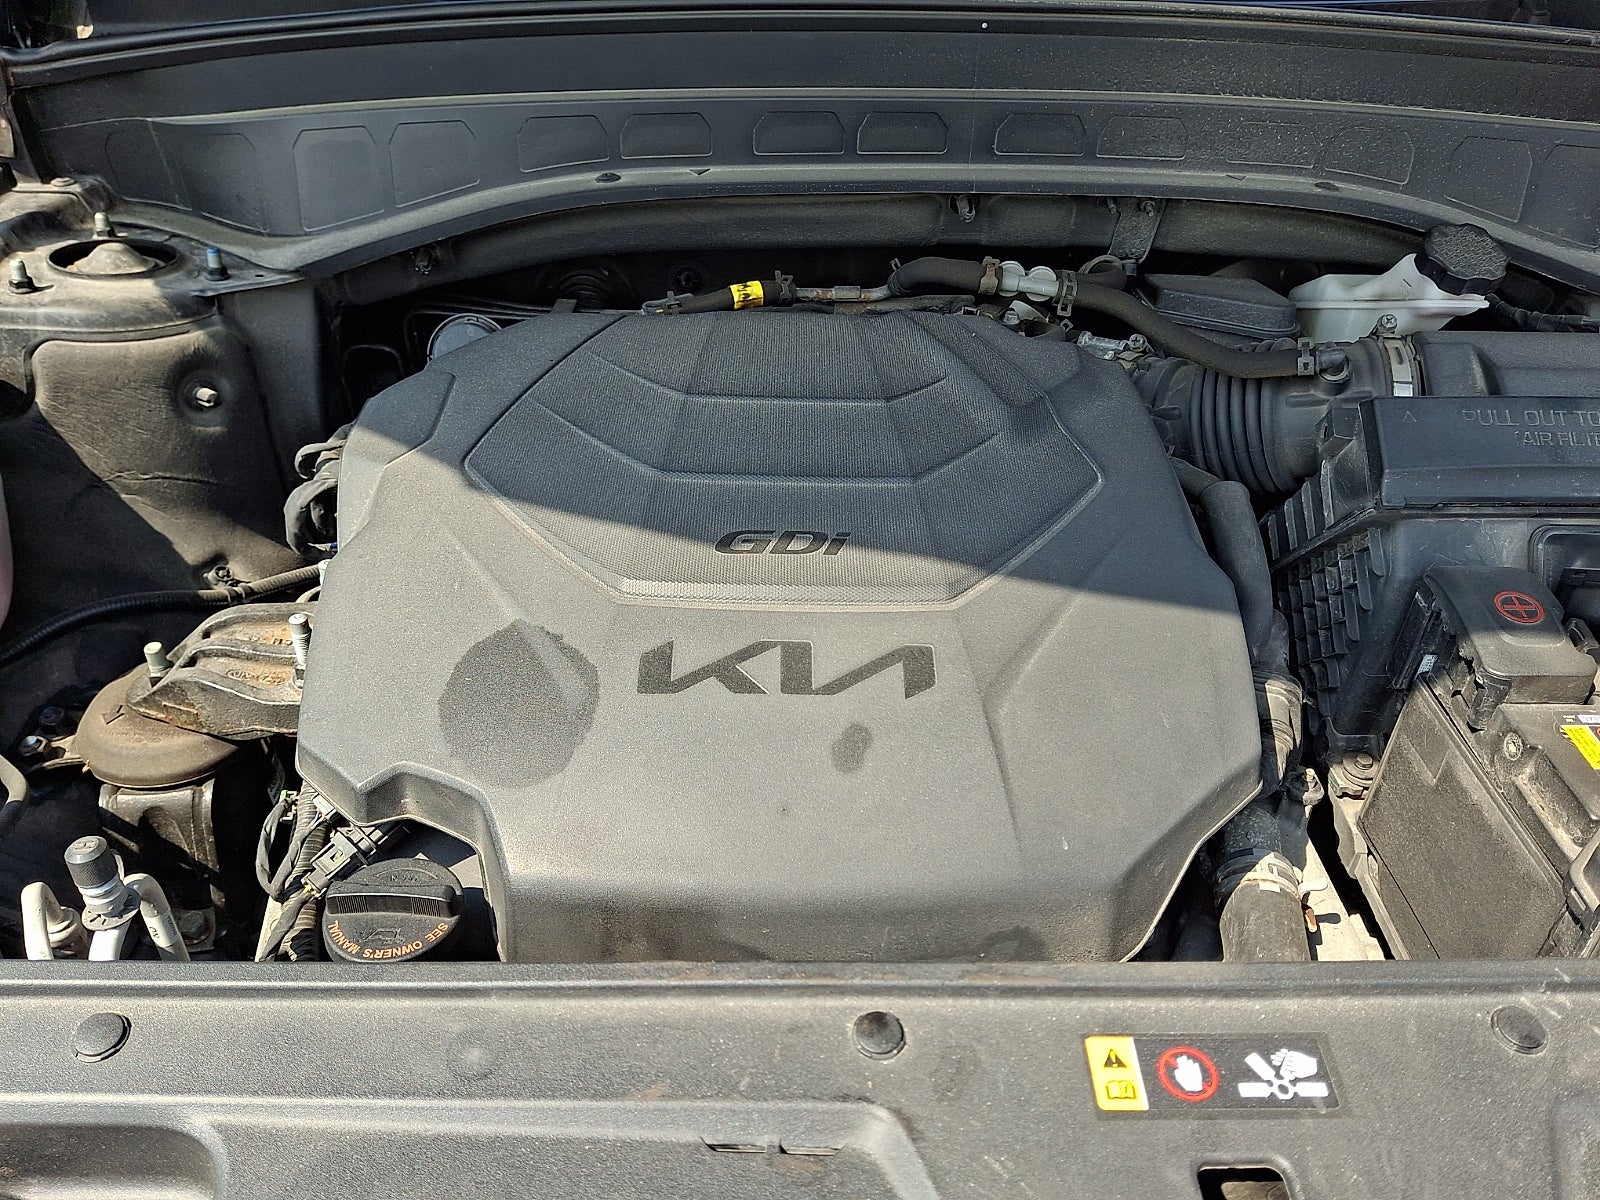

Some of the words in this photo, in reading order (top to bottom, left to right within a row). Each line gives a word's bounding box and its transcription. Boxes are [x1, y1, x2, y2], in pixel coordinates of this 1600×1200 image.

[1462, 409, 1520, 426] PULL
[1524, 410, 1568, 426] OUT
[1573, 410, 1600, 427] TO
[637, 639, 937, 700] KIA
[327, 919, 361, 955] MANUAL
[425, 922, 449, 943] SEE
[362, 940, 423, 959] OWNER'S
